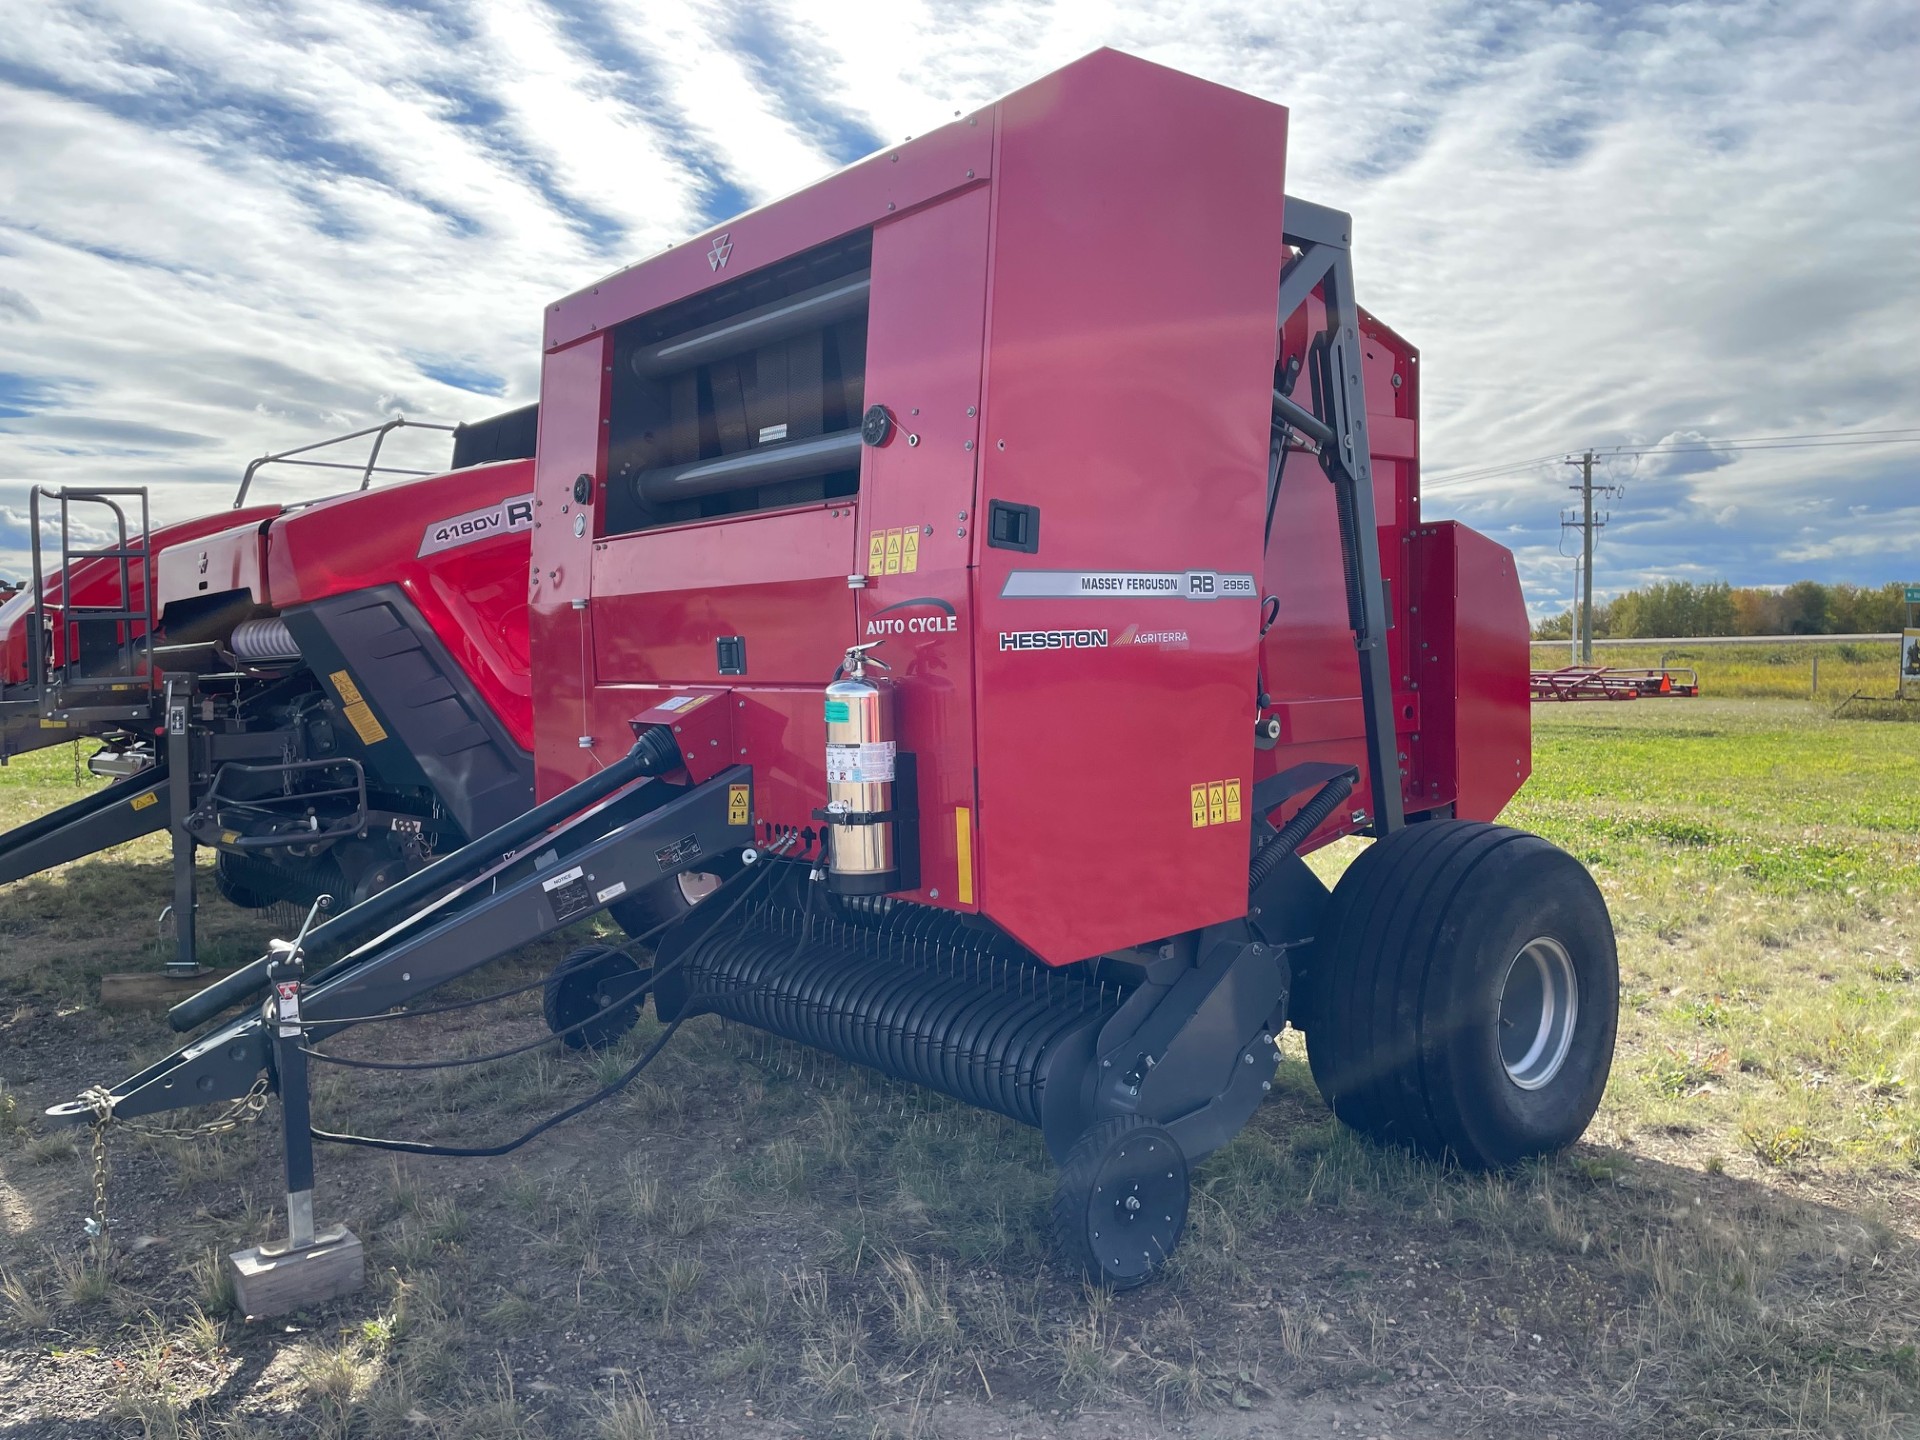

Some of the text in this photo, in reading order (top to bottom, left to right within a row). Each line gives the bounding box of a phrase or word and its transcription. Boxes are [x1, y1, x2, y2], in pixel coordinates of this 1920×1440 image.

[435, 513, 501, 541] 4180V
[1081, 575, 1250, 594] MASSEY FERGUSON RB 2956
[866, 615, 957, 635] AUTO CYCLE
[999, 629, 1108, 651] HESSTON
[1134, 631, 1188, 645] AGRITERRA
[553, 872, 572, 885] NOTICE
